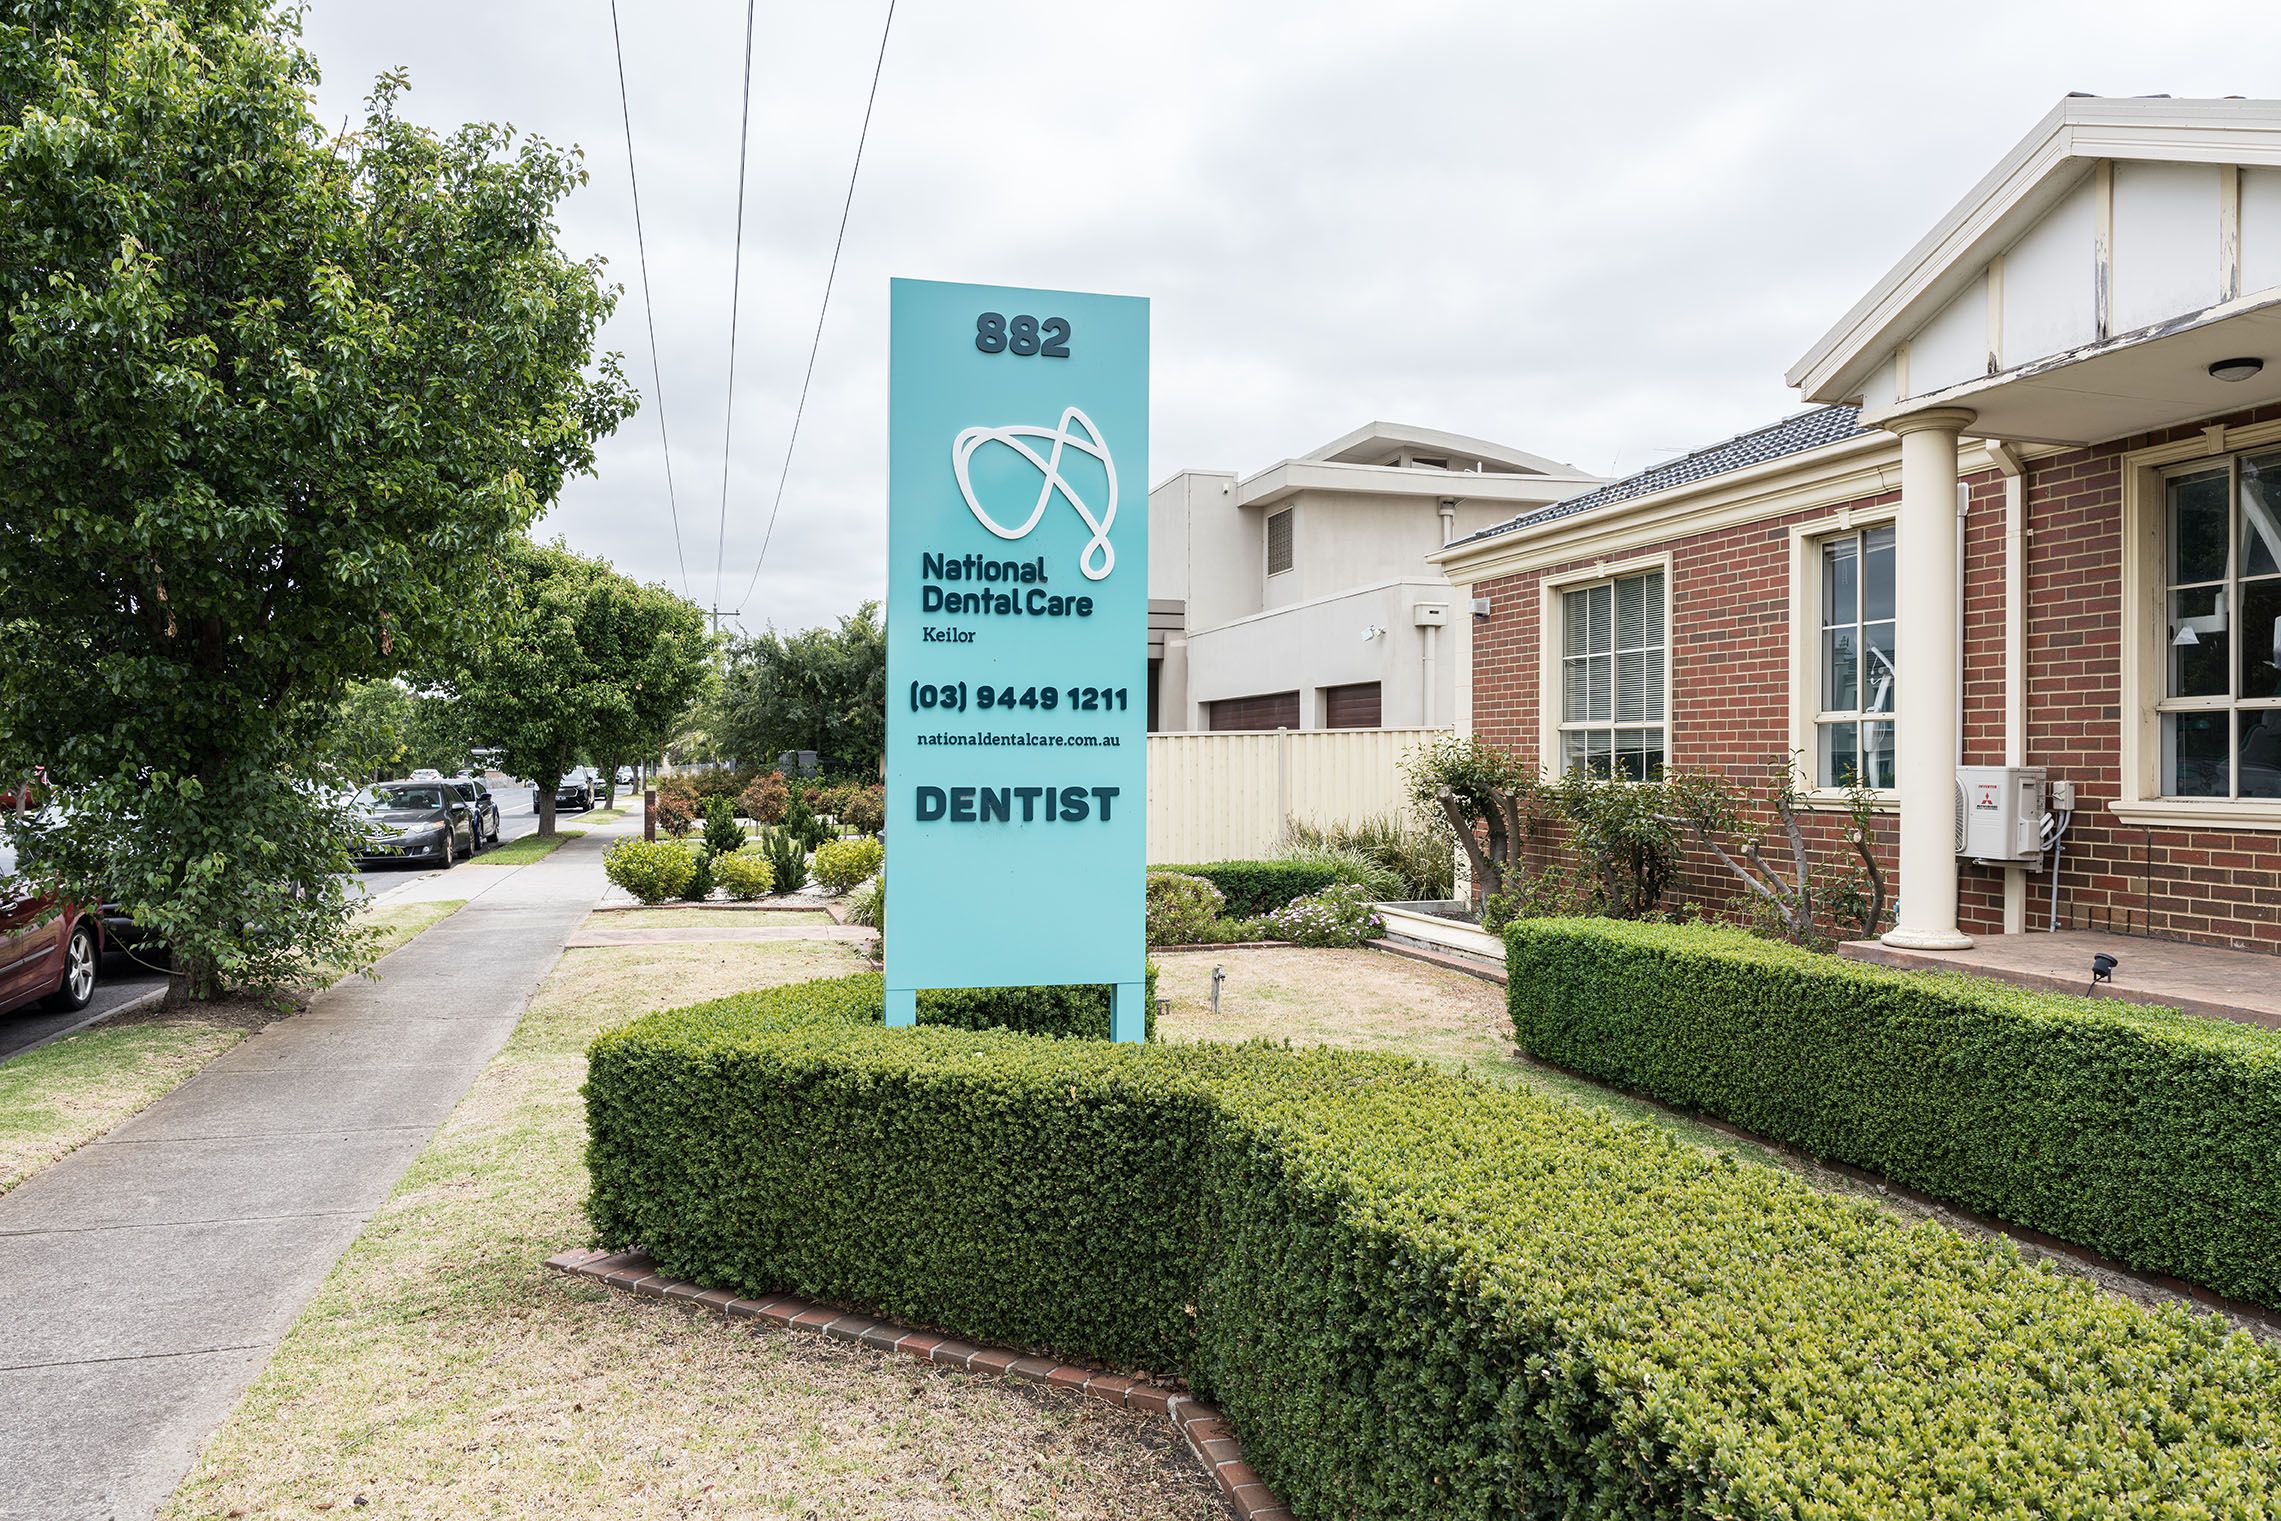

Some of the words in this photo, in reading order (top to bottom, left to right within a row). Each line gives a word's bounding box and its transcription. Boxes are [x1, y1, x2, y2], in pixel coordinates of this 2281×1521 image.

[975, 311, 1071, 358] 882
[923, 552, 1048, 583] National
[923, 585, 1022, 615] Dental
[1026, 589, 1093, 617] Care
[923, 627, 976, 643] Keilor
[910, 681, 967, 712] (03)
[976, 686, 1058, 710] 9449
[1067, 687, 1128, 711] 1211
[917, 732, 1120, 747] nationaldentalcare.com.au
[916, 786, 1120, 822] DENTIST
